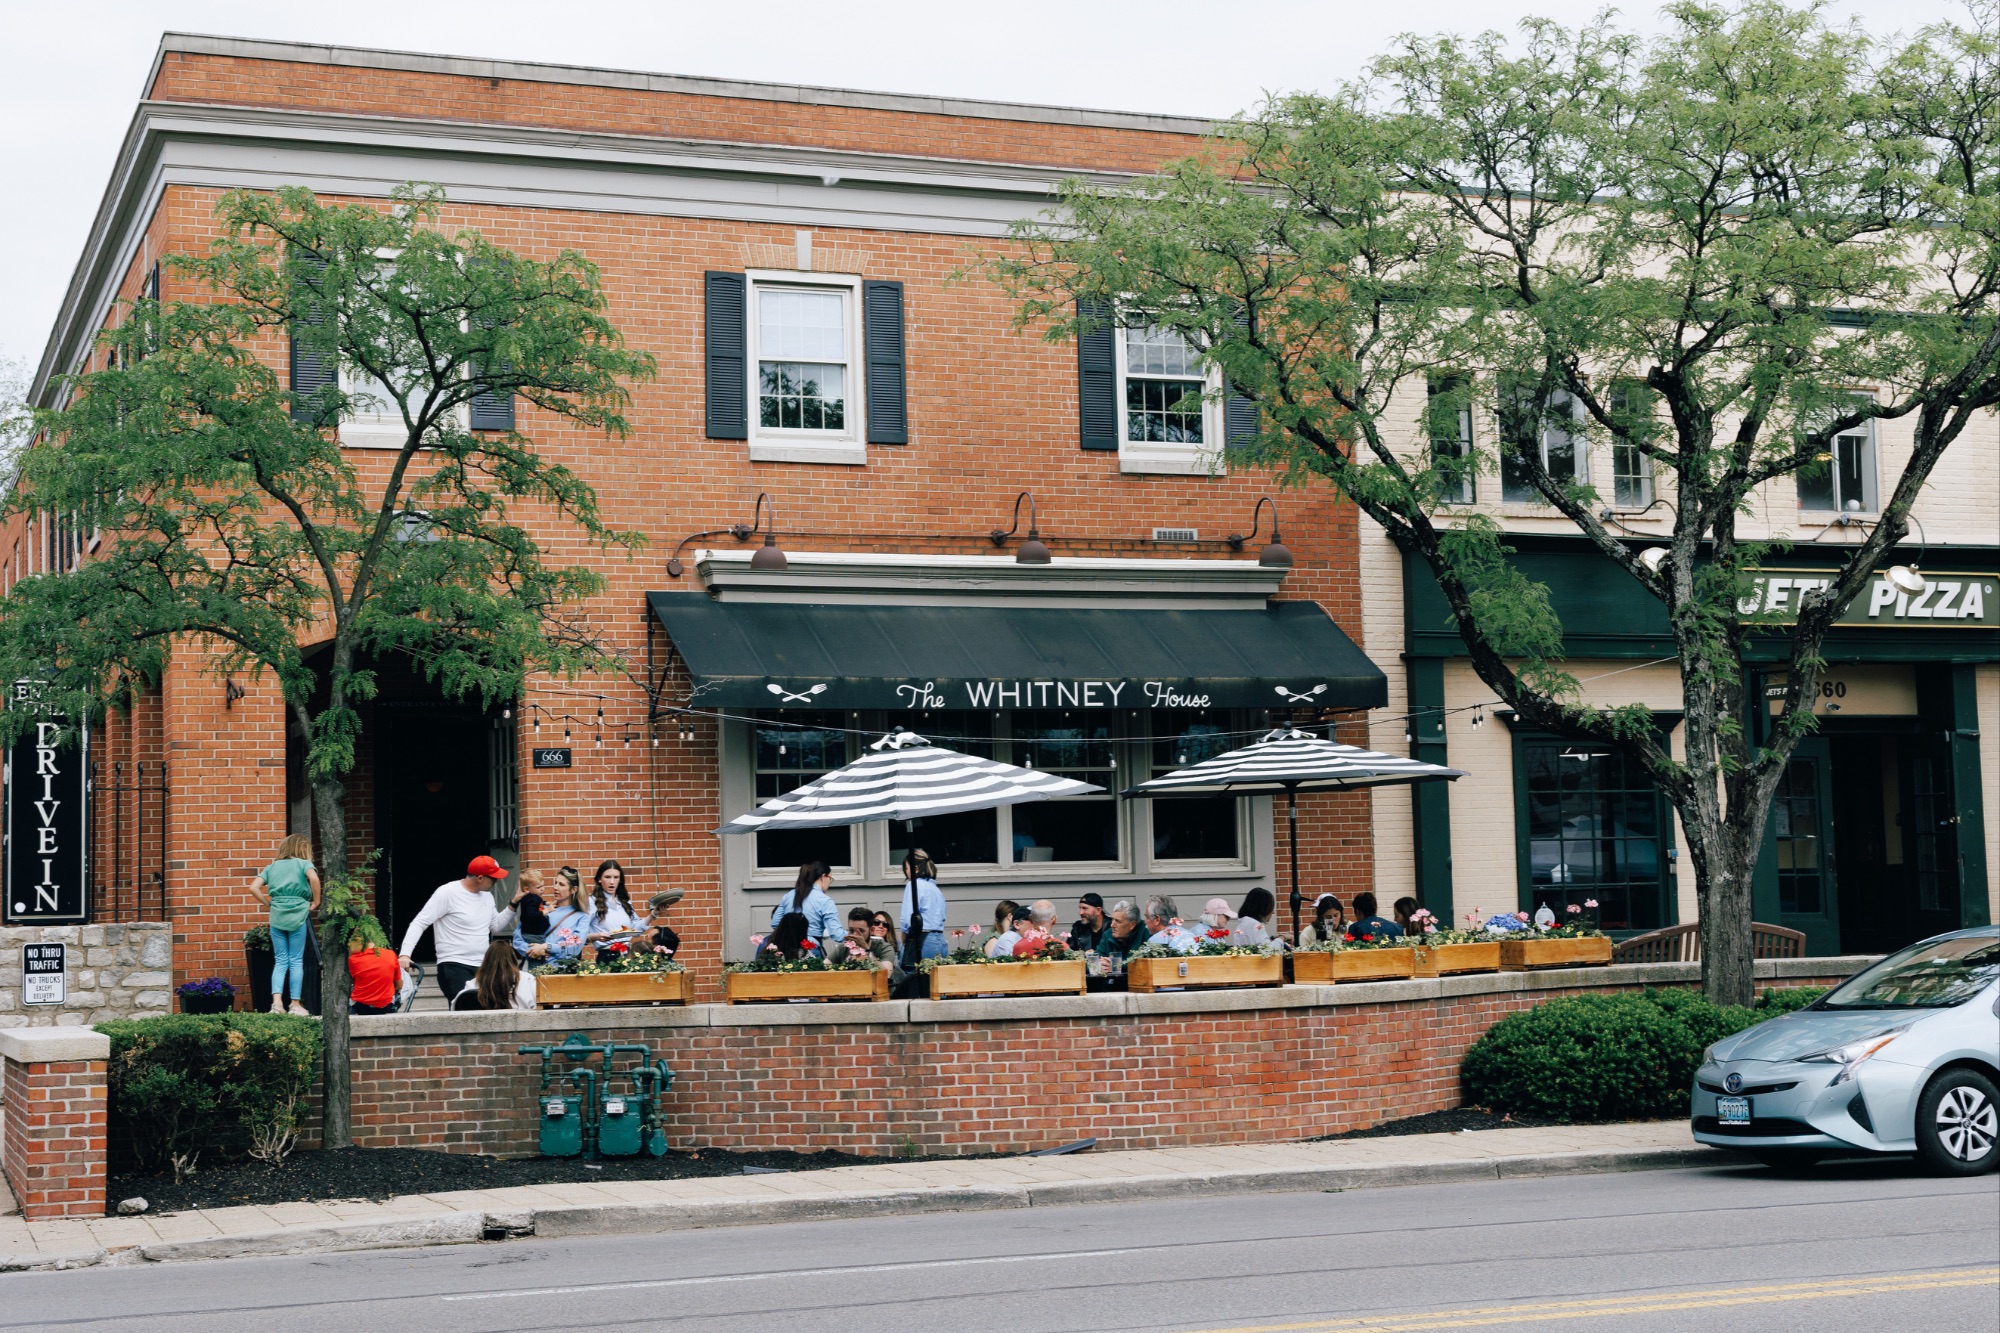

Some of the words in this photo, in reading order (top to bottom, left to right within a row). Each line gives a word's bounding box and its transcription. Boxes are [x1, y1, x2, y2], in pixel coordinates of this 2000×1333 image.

[1737, 578, 1849, 615] JET'
[1868, 580, 1984, 618] PIZZA
[896, 681, 945, 708] The
[965, 681, 1126, 707] WHITNEY
[1143, 681, 1211, 708] House
[542, 750, 563, 761] 666
[27, 948, 39, 958] NO
[41, 947, 61, 958] THRU
[29, 960, 59, 970] TRAFFIC
[28, 976, 36, 984] NO
[38, 976, 61, 984] TRUCKS
